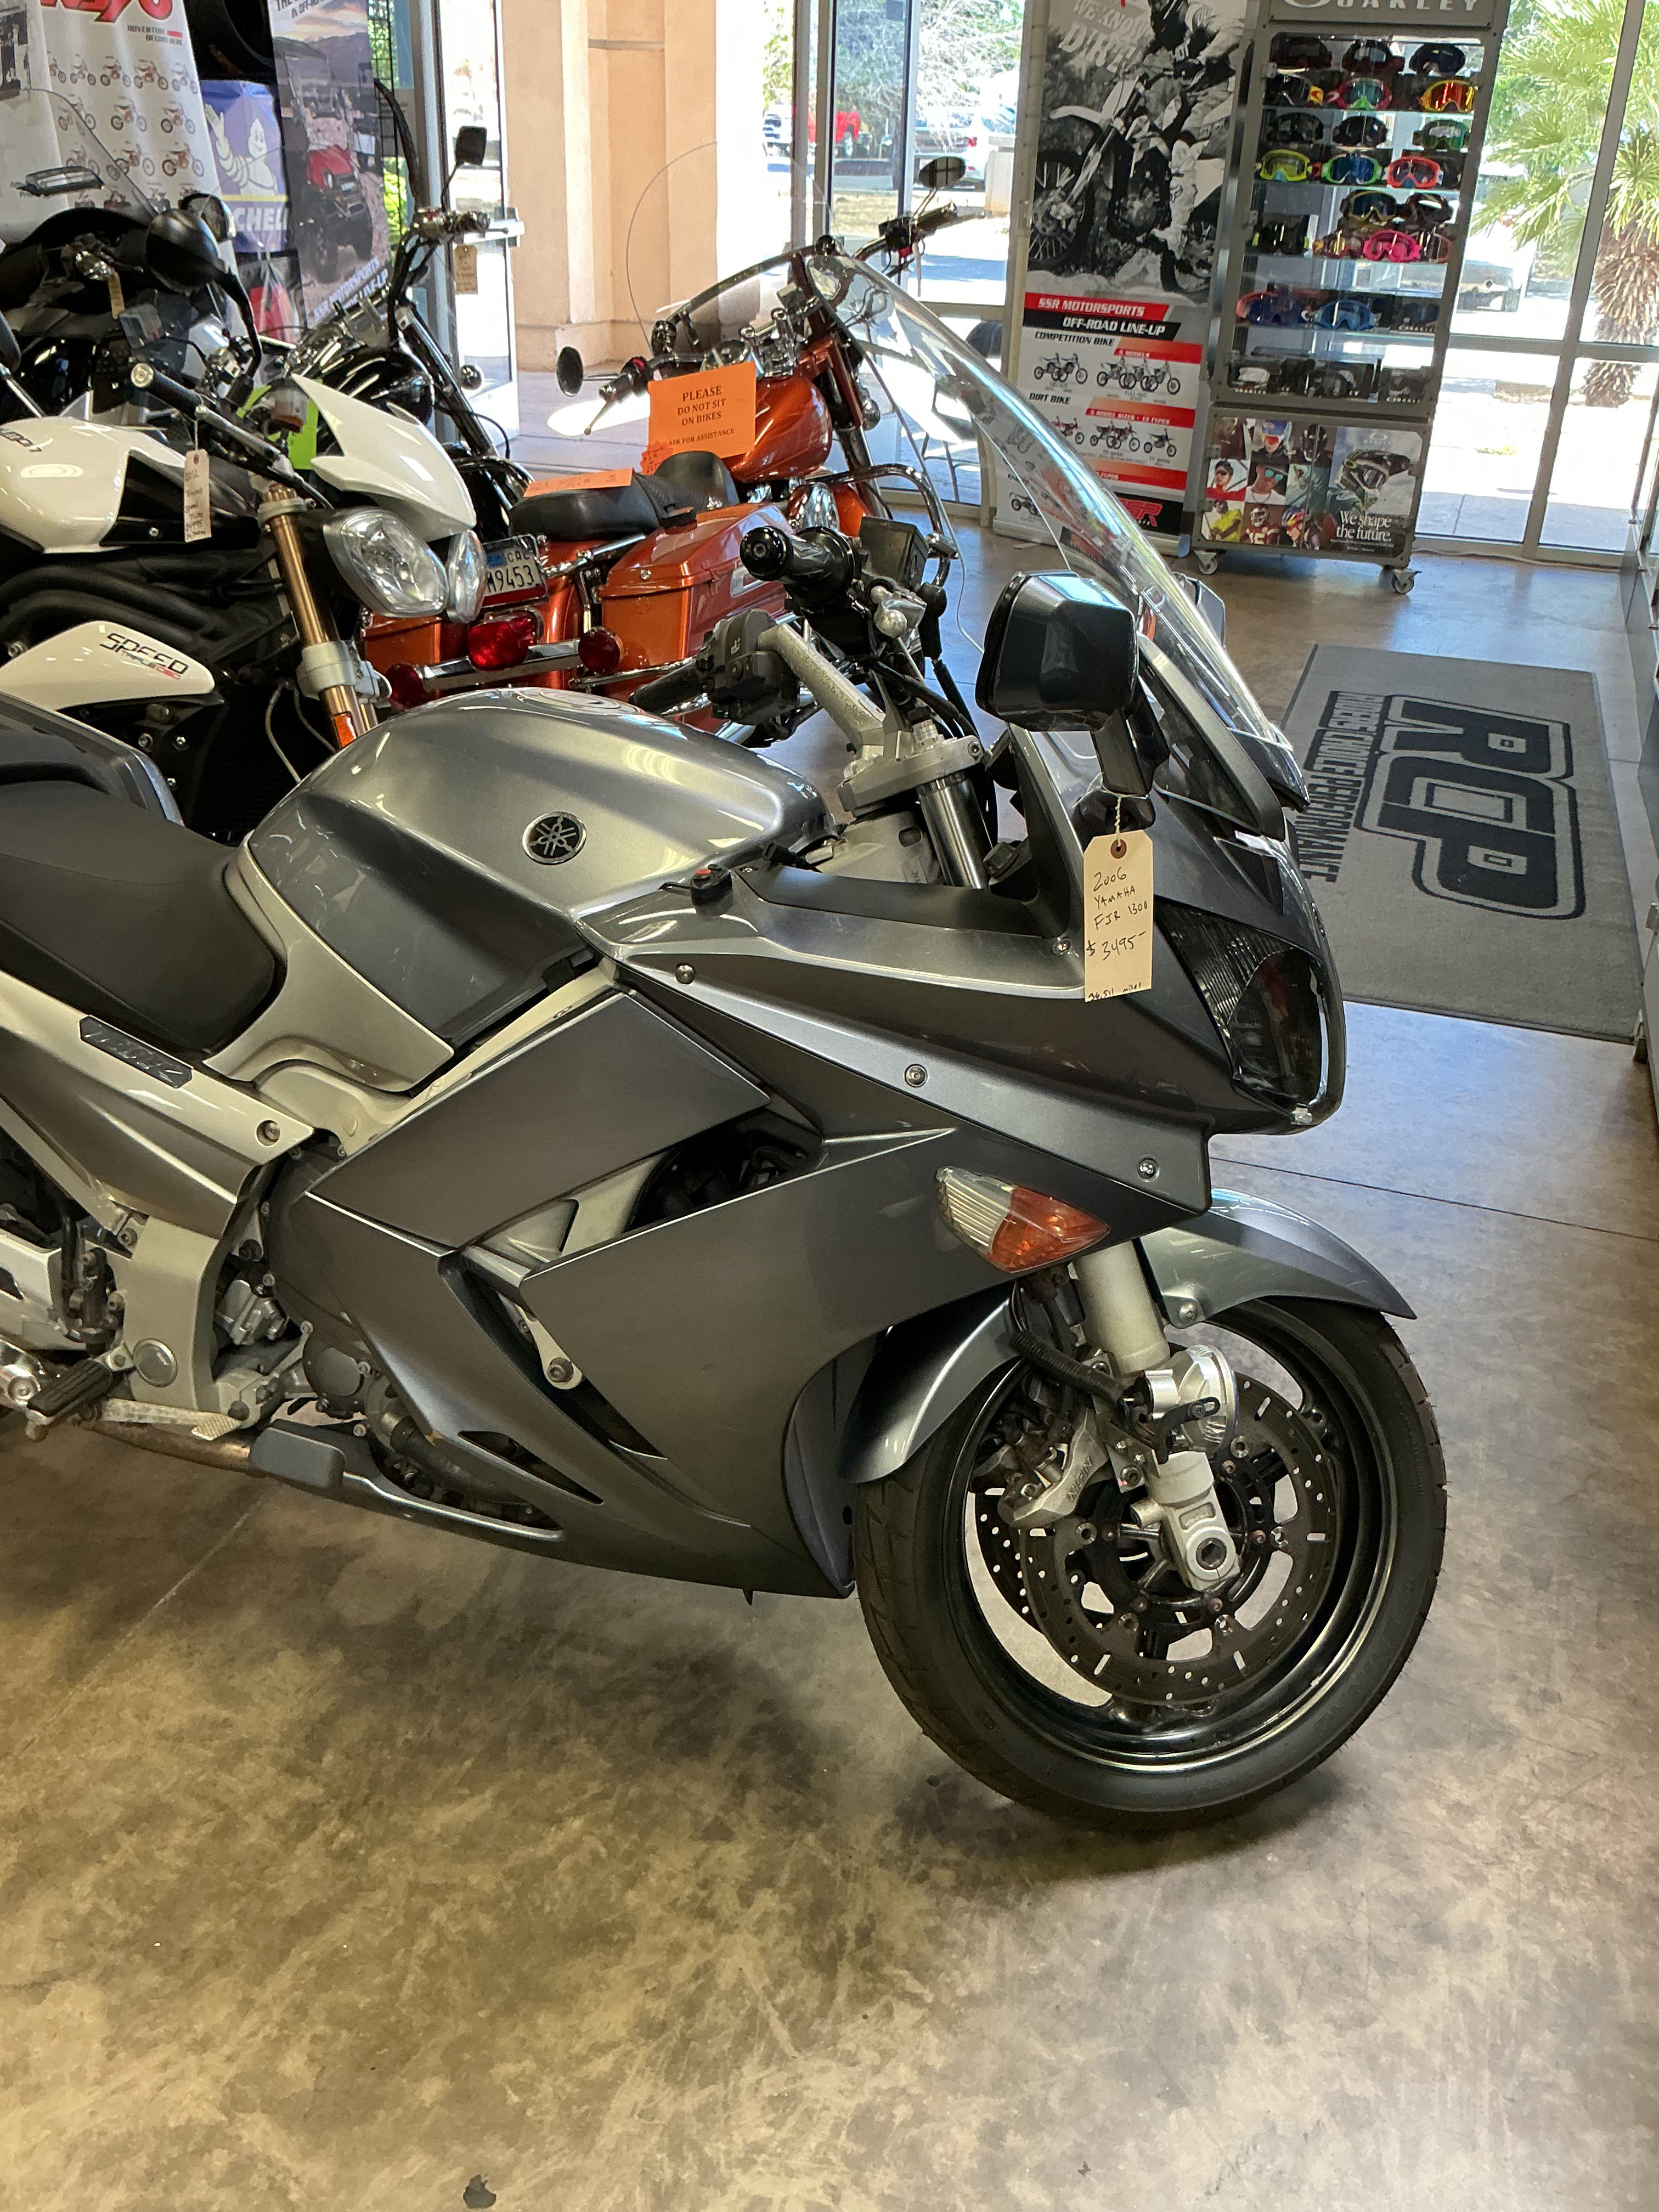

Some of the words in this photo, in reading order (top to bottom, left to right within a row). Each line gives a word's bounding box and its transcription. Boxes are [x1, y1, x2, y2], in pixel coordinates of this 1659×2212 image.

[1037, 298, 1059, 309] SSR
[1062, 299, 1146, 318] MOTORSPORTS
[1063, 317, 1118, 331] OFF-ROAD
[1120, 322, 1166, 336] LINE-UP
[1035, 331, 1092, 345] COMPETITION
[1093, 336, 1115, 346] BIKE
[682, 385, 722, 402] PLEASE
[1029, 392, 1048, 402] DIRT
[1050, 396, 1070, 405] BIKE
[677, 406, 690, 416] DO
[692, 402, 711, 413] NOT
[712, 398, 727, 408] SIT
[1096, 411, 1116, 420] MODEL
[681, 416, 694, 426] ON
[696, 410, 722, 424] BIKES
[682, 436, 696, 445] FOR
[696, 428, 735, 442] ASSISTANCE
[1339, 510, 1357, 525] We
[1357, 512, 1392, 531] shape
[1336, 524, 1355, 539] the
[1356, 526, 1392, 542] future.
[99, 633, 189, 675] SPEED
[1314, 732, 1374, 775] CHOICE
[1295, 775, 1363, 883] PERFORMANCE
[1093, 866, 1126, 891] 2006
[1093, 911, 1121, 930] FJR
[1128, 900, 1148, 915] 1300
[1088, 988, 1115, 1001] 36,511
